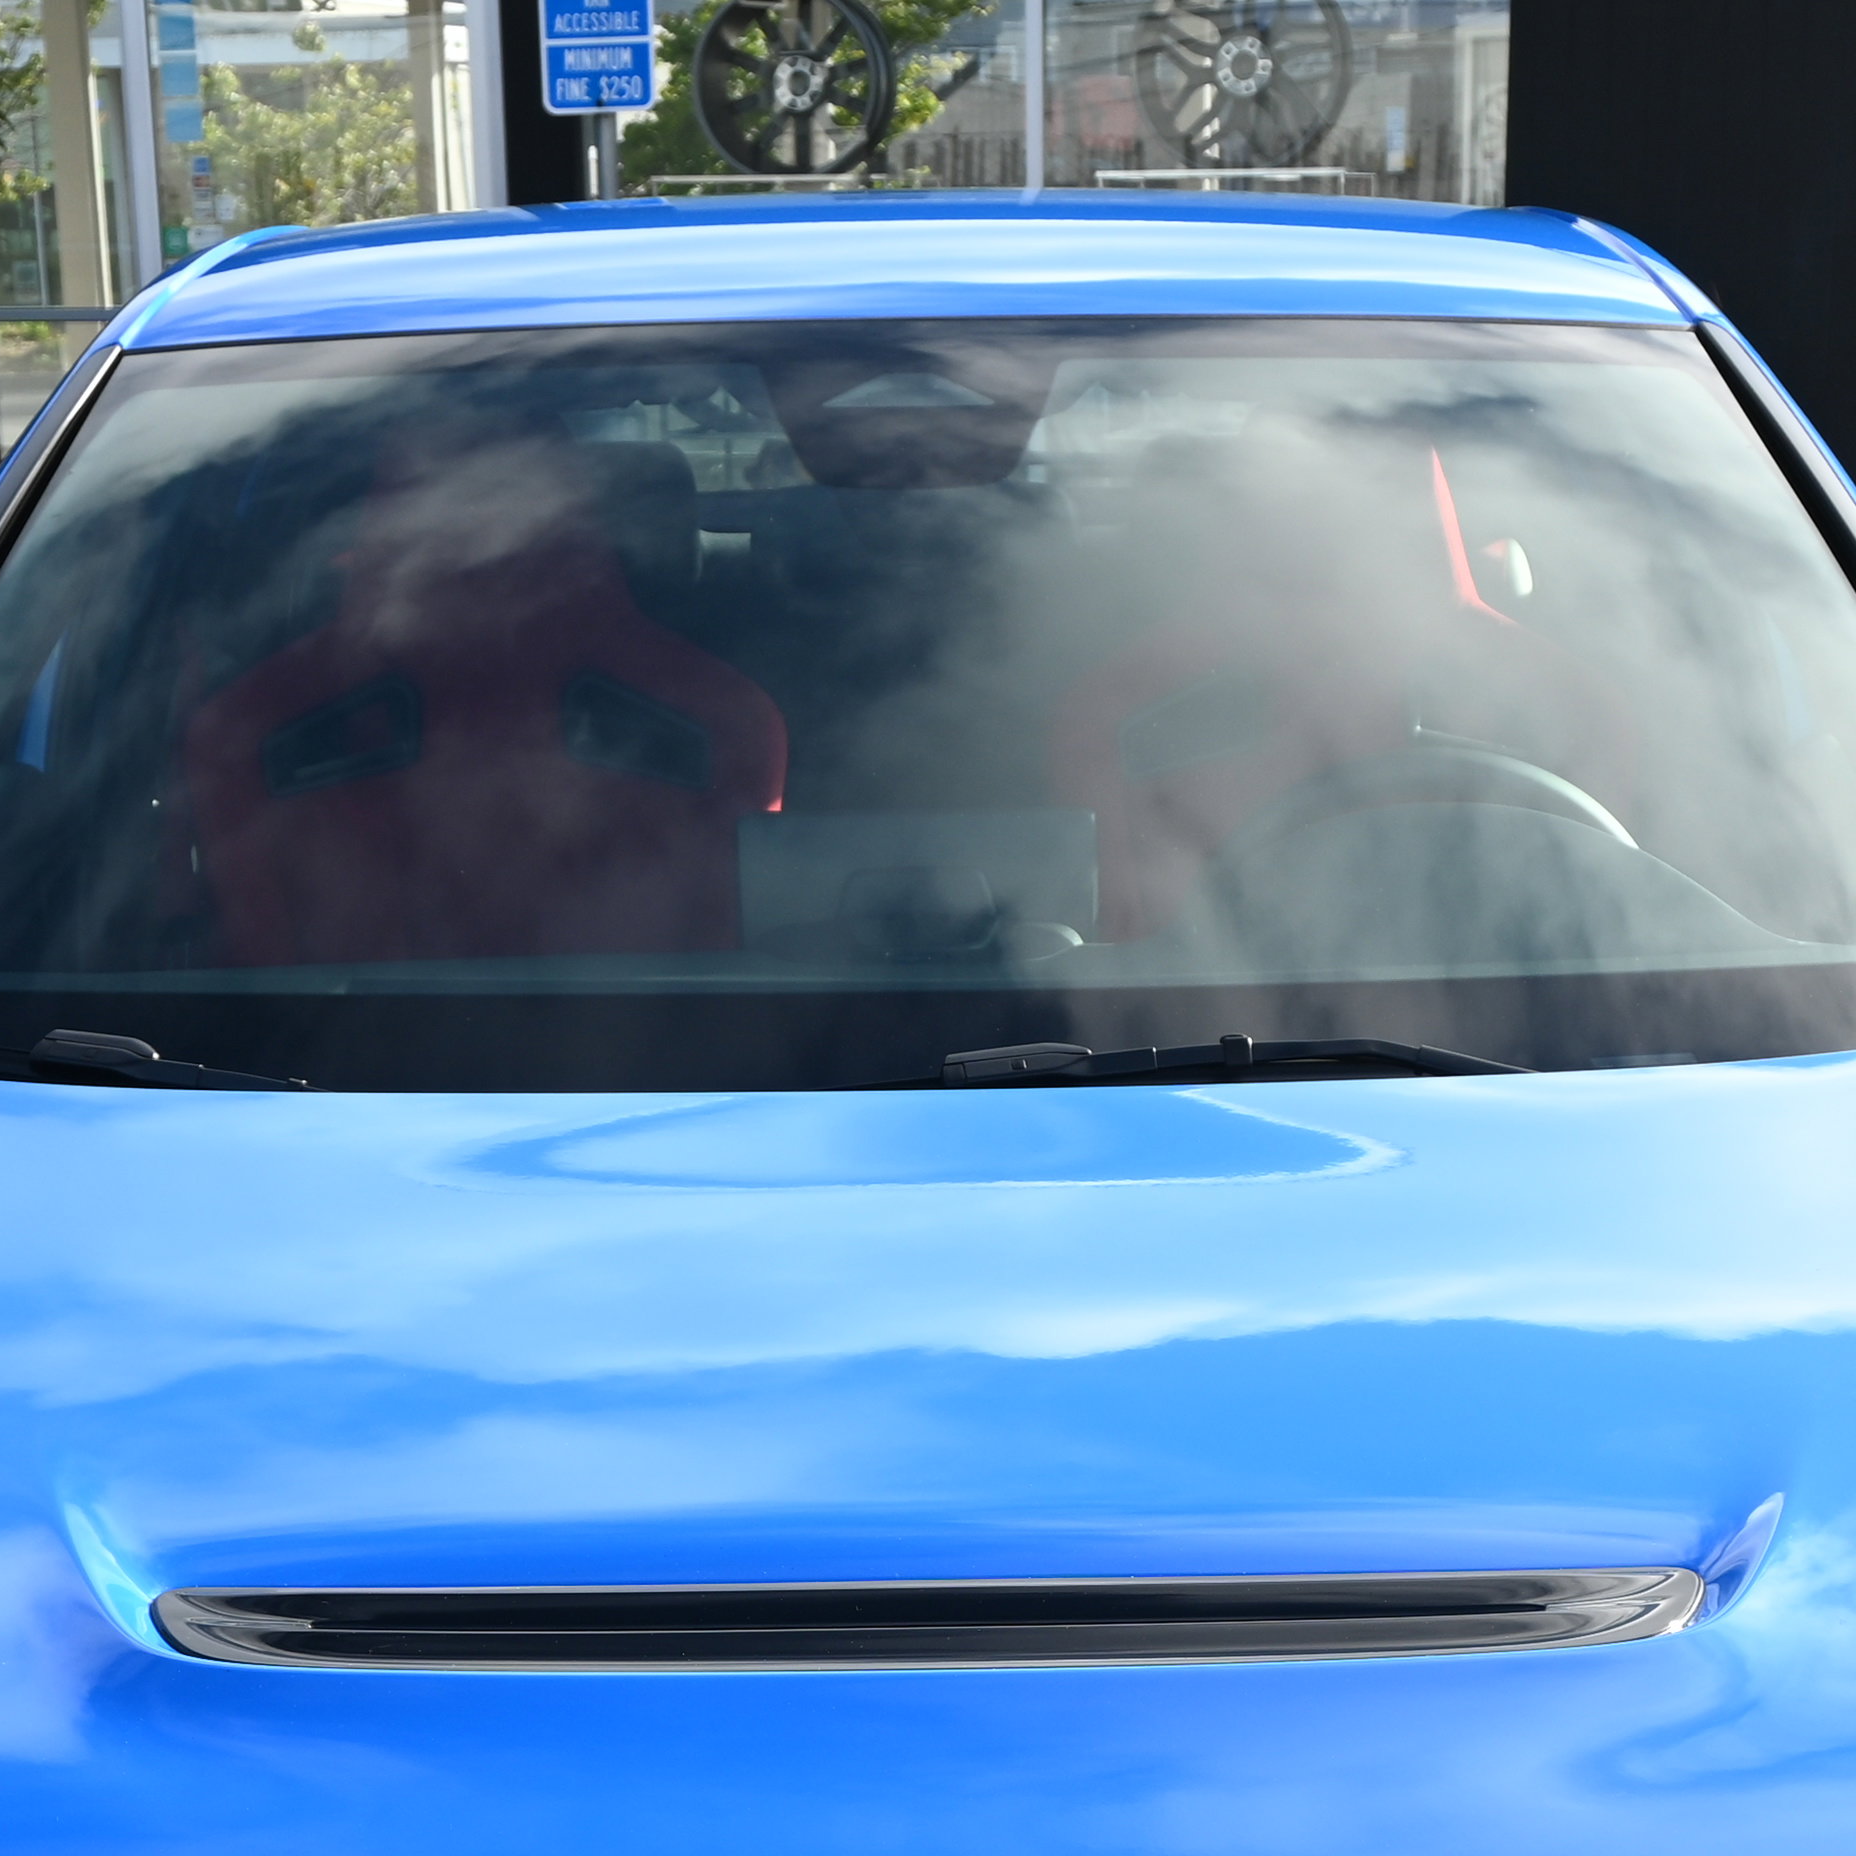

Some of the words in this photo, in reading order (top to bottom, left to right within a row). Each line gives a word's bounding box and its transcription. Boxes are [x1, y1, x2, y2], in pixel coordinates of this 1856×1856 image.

[553, 11, 640, 33] ACCESSIBLE
[563, 47, 633, 71] MINIMUM
[556, 78, 591, 101] FINE
[600, 75, 643, 100] $250
